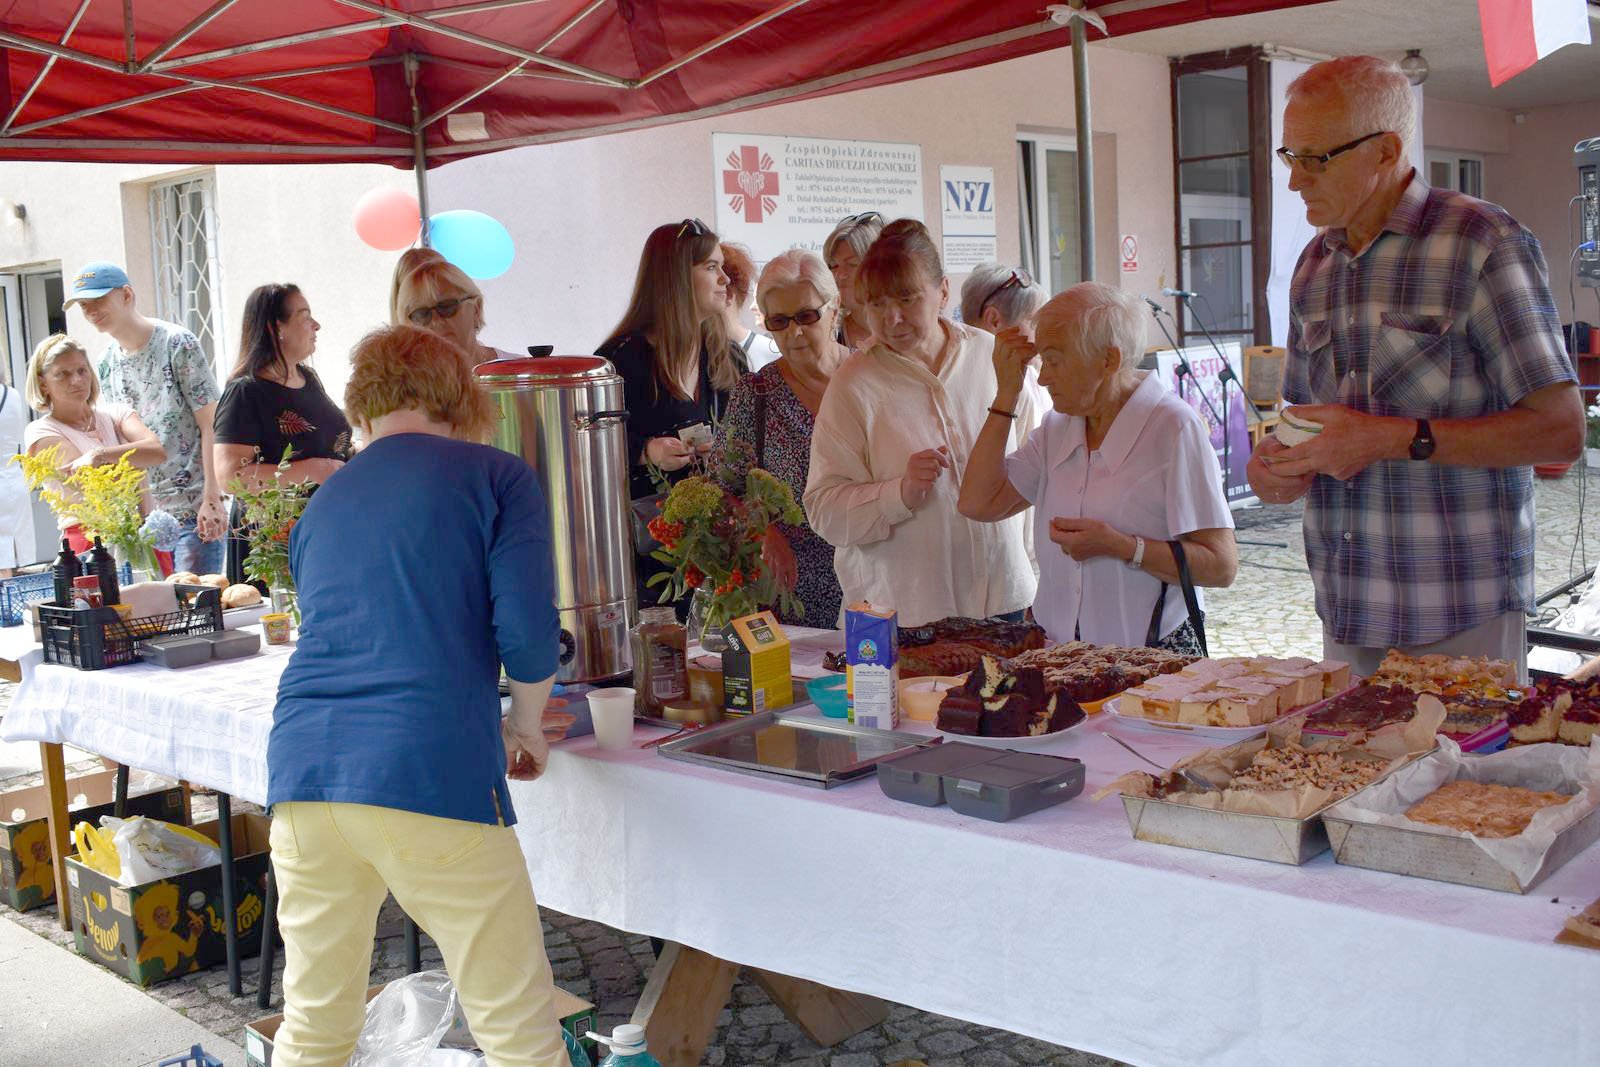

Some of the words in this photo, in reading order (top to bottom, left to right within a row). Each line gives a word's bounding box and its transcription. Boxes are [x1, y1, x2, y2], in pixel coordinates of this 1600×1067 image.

[823, 145, 857, 159] Opieki
[785, 157, 824, 168] CARITAS
[826, 159, 865, 170] DIECEZJI
[867, 161, 916, 172] LEGNICKIEJ
[944, 180, 993, 212] NFZ
